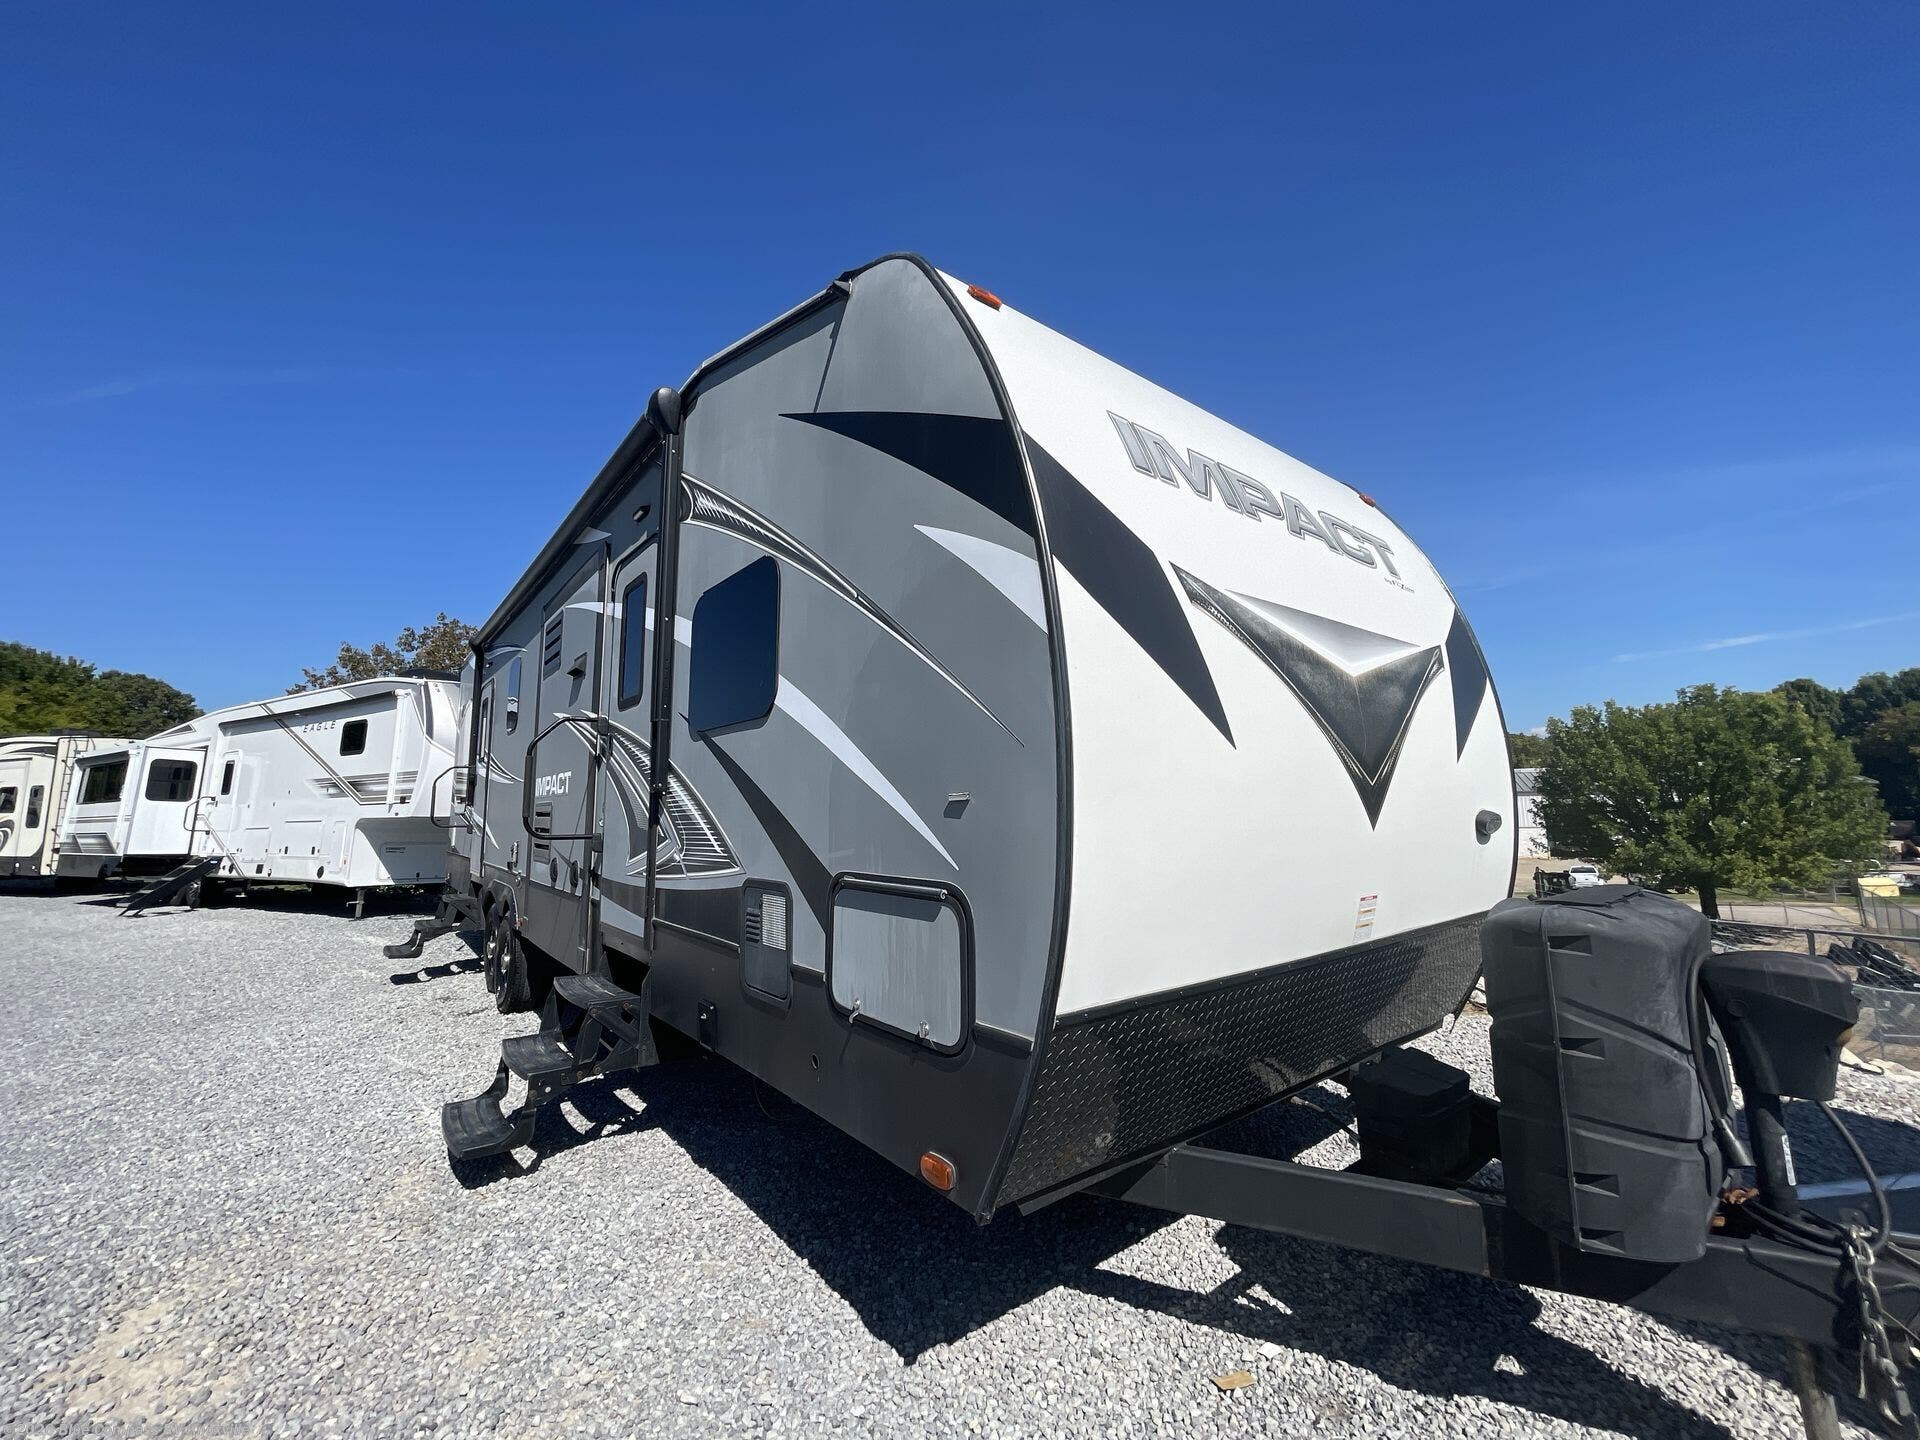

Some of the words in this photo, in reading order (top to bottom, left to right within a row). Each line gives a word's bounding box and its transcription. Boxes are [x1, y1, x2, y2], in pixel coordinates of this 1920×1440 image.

[1106, 410, 1401, 581] IMPACT
[303, 720, 336, 733] EAGLE
[535, 771, 572, 797] IMPACT
